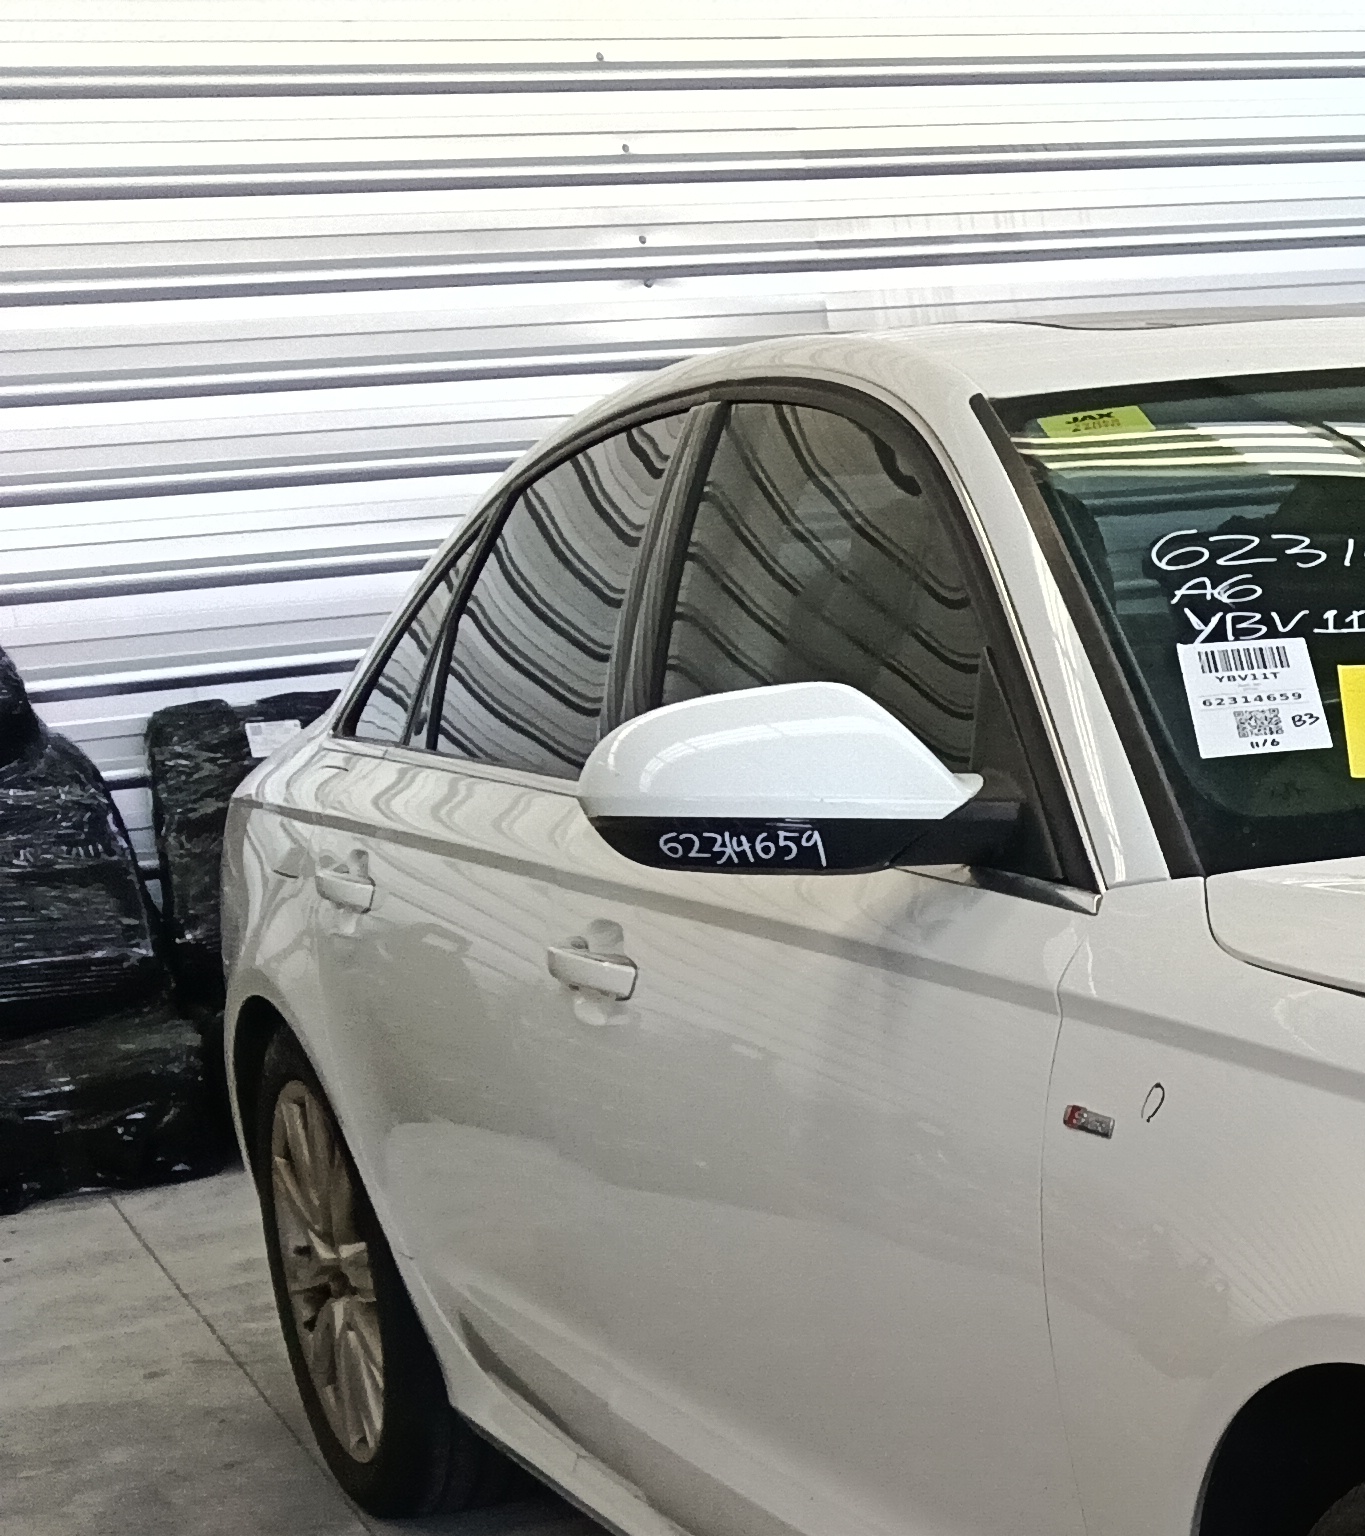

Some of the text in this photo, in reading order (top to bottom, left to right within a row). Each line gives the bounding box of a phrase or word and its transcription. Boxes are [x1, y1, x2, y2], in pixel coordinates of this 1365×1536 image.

[1171, 573, 1263, 604] A6
[1215, 671, 1280, 683] YBV11T
[1202, 692, 1302, 707] 62314659
[1291, 712, 1320, 728] B3
[1250, 738, 1281, 749] 11/6
[658, 830, 827, 867] 62314659
